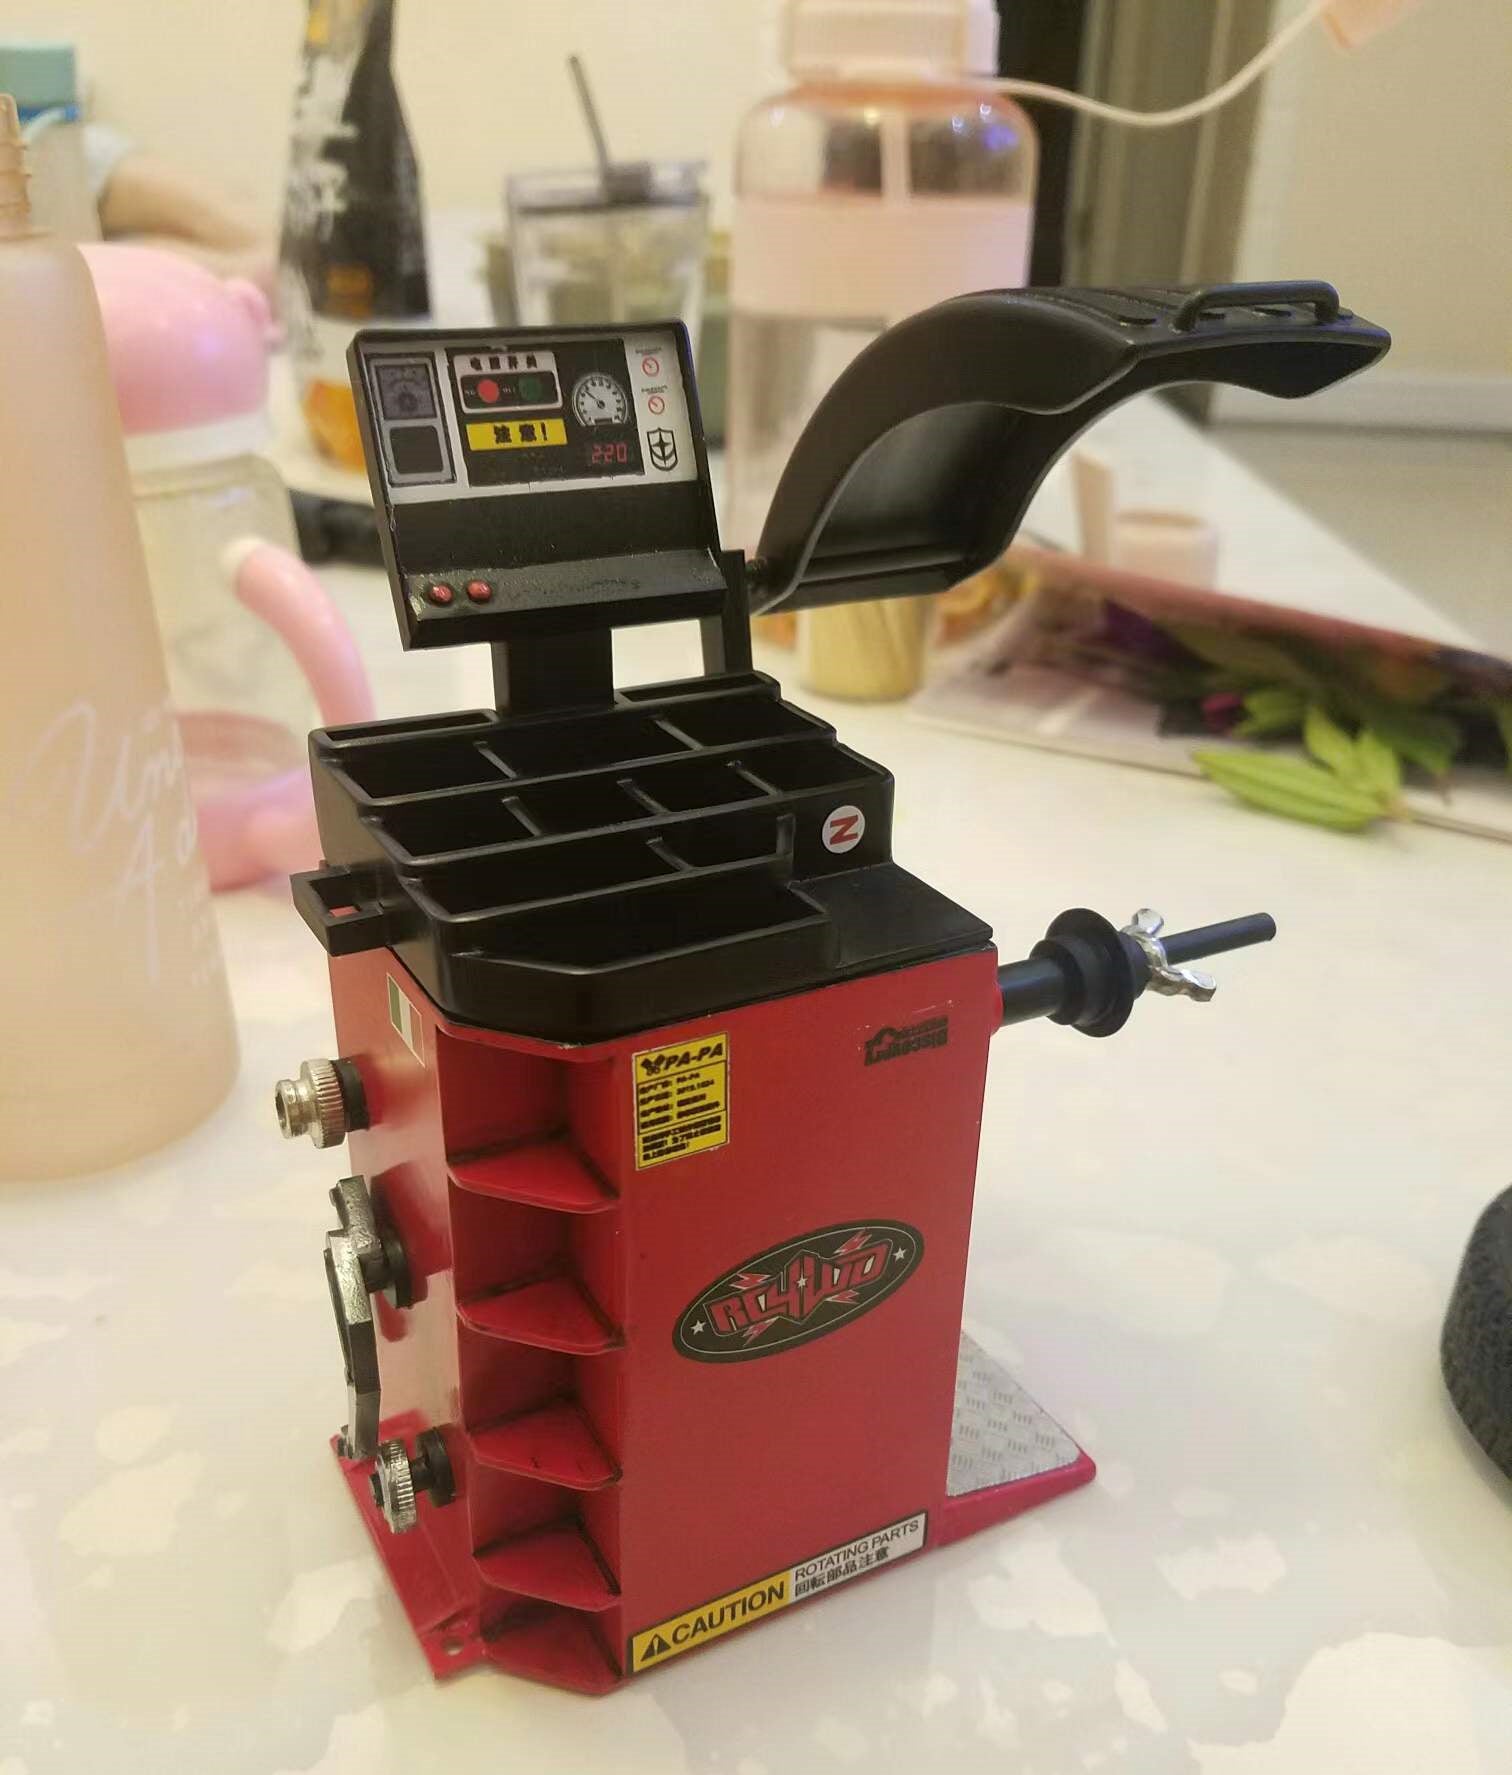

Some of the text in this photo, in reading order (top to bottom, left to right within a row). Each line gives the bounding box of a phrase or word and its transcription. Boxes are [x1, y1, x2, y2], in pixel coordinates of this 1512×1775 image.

[591, 442, 629, 464] 220
[664, 1043, 724, 1070] PA-PA
[794, 1519, 919, 1581] ROTATING PARTS
[671, 1581, 785, 1645] CAUTION
